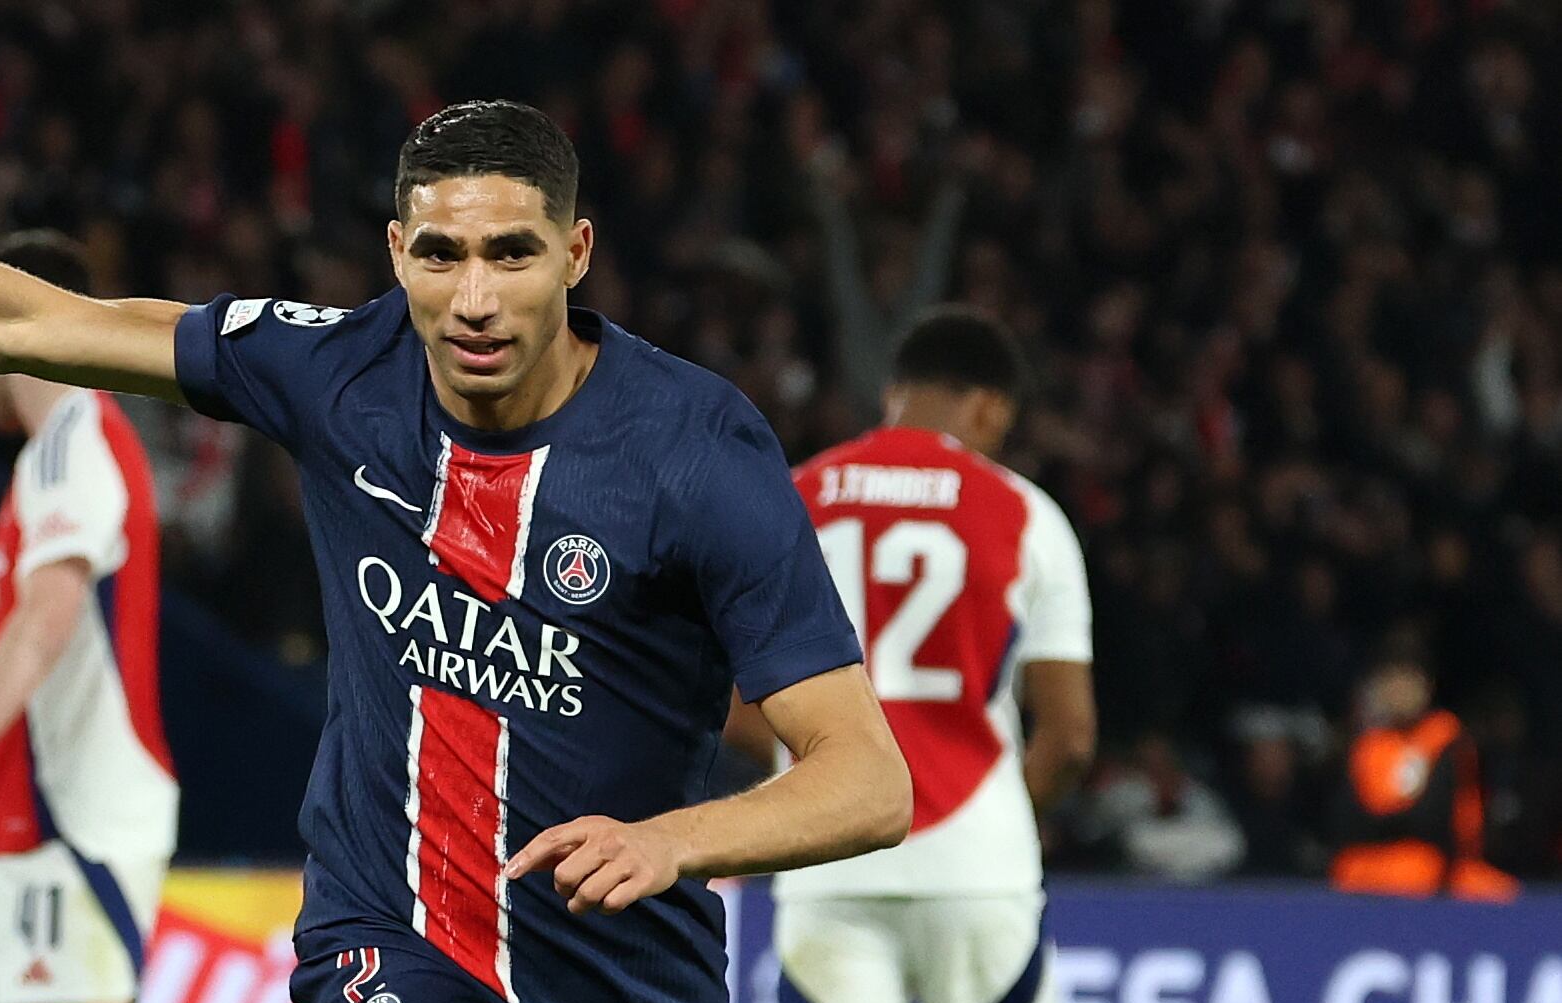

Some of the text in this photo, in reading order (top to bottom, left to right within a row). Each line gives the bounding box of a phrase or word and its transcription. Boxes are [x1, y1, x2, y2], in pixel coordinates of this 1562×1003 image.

[558, 538, 602, 560] PARIS
[357, 555, 584, 679] QATAR
[818, 517, 968, 702] 12
[398, 638, 583, 717] AIRWAYS
